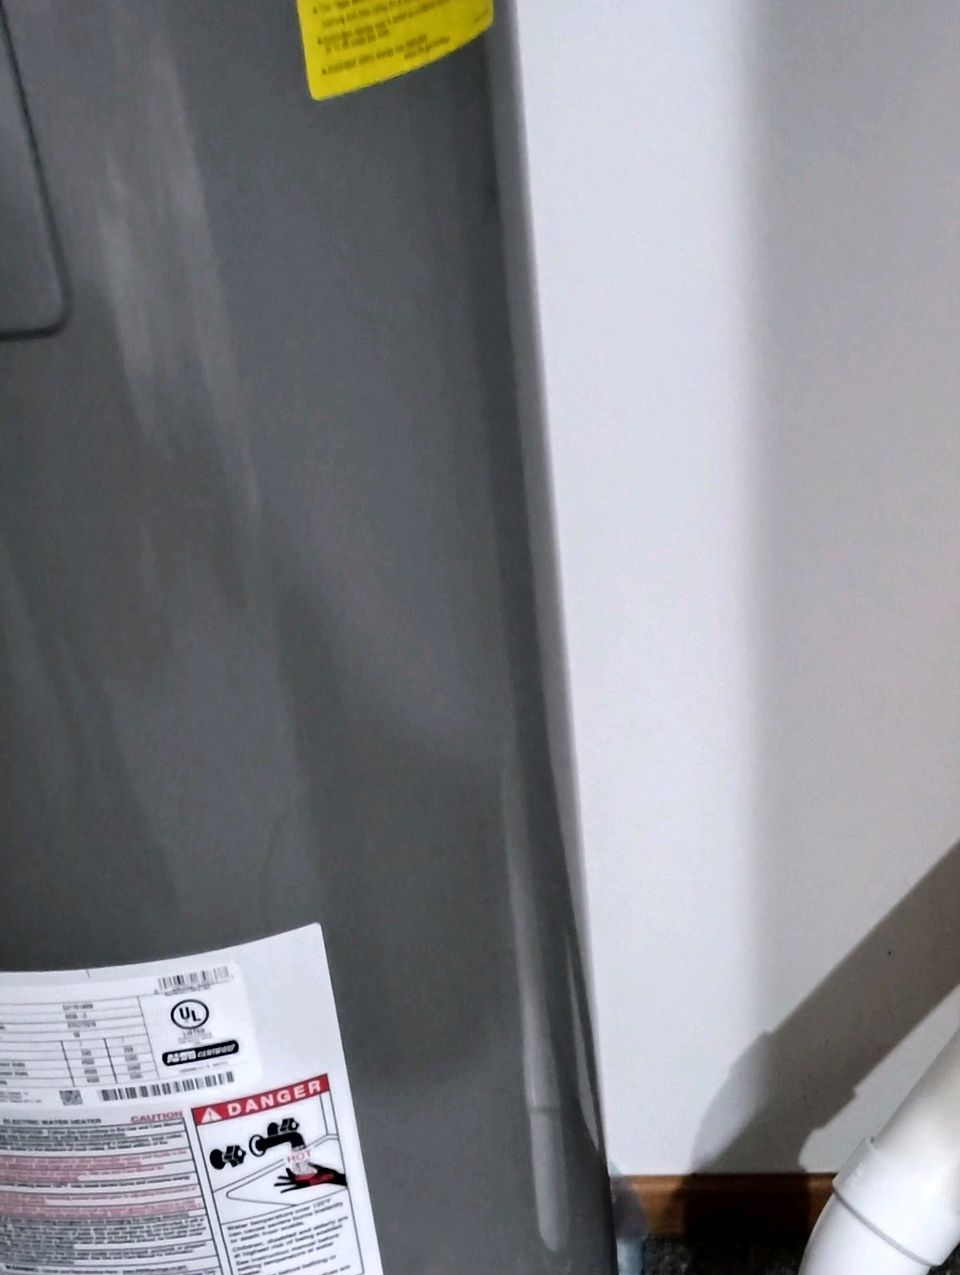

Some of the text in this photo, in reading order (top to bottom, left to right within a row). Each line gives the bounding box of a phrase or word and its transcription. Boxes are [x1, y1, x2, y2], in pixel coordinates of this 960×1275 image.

[179, 1006, 201, 1022] UL
[226, 1079, 321, 1117] DANGER
[131, 1111, 183, 1123] CAUTION
[287, 1150, 312, 1164] HOT
